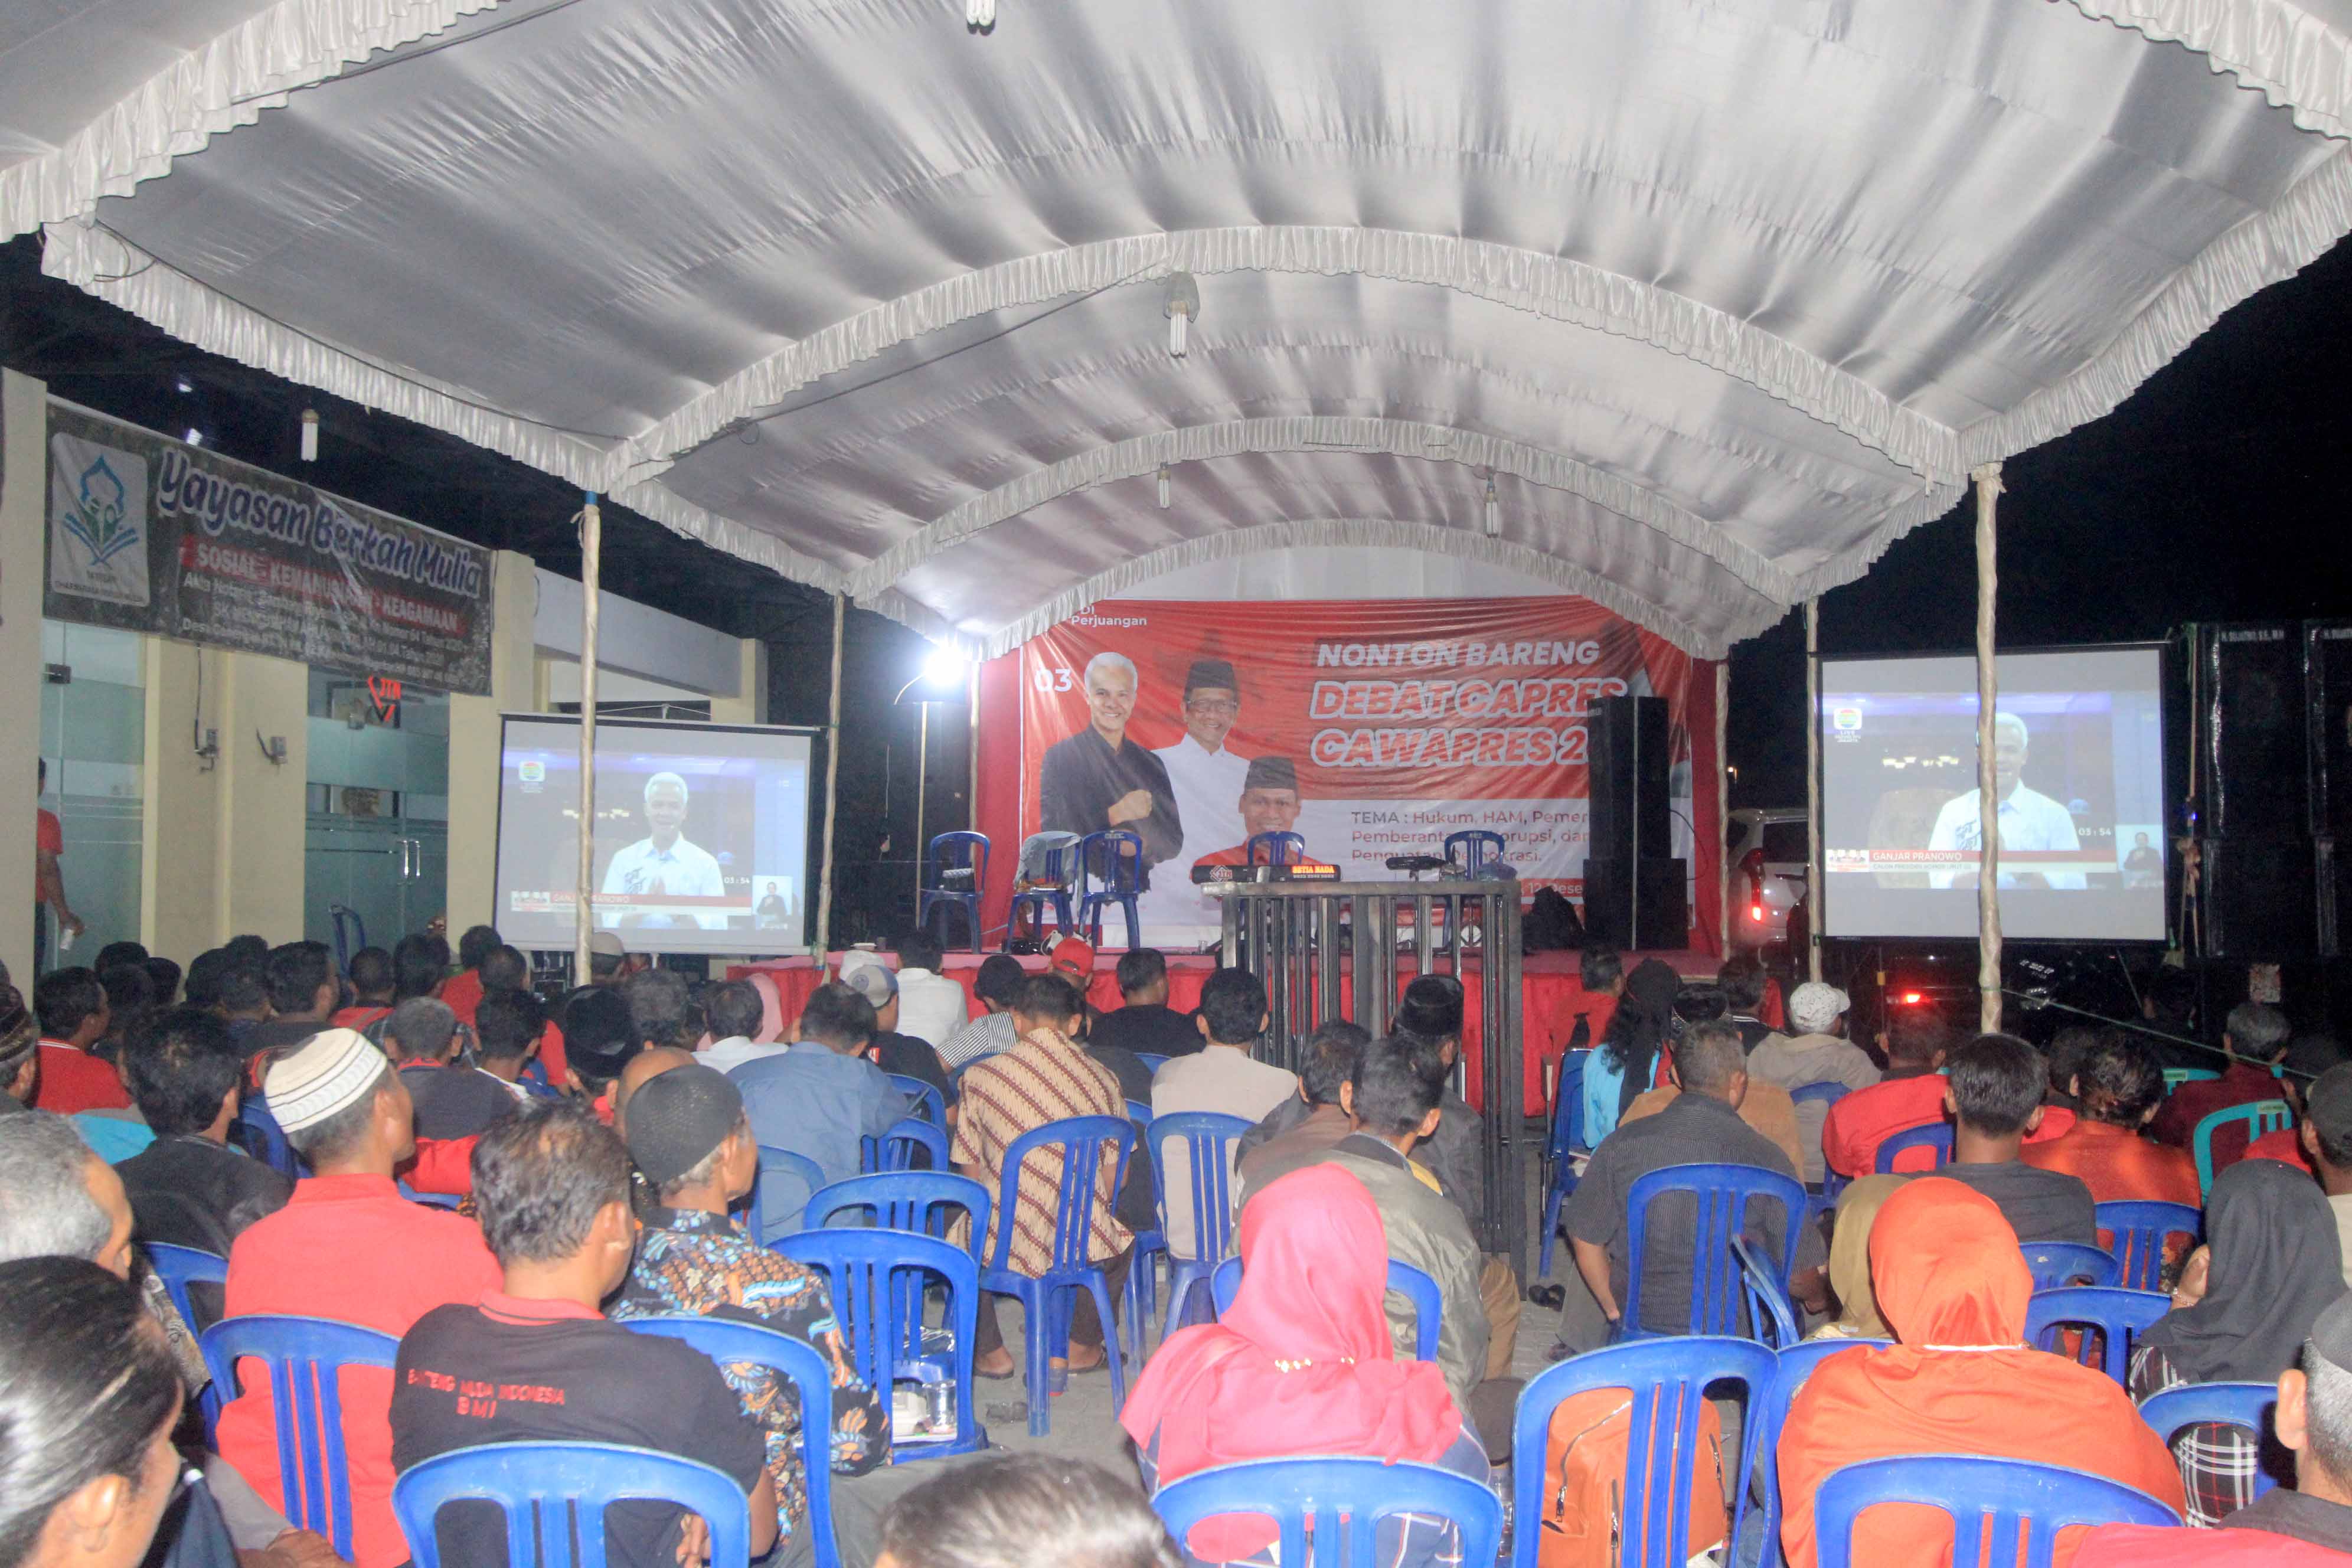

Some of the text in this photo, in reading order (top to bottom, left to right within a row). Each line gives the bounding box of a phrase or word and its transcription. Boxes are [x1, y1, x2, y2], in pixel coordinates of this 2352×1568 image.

[156, 447, 482, 599] Yayasan Berkah Mulia
[384, 594, 459, 631] KEAGAMAAN
[1072, 615, 1147, 628] Perjuangan
[1317, 641, 1600, 667] NONTON BARENG
[1034, 668, 1072, 692] 03
[1309, 680, 1458, 719] DEBAT
[1311, 727, 1559, 767] CAWAPRES
[1351, 811, 1399, 824] TEMA
[1413, 811, 1477, 825] Hukum,
[1483, 811, 1527, 825] HAM,
[1503, 829, 1556, 845] orupsi,
[1873, 851, 1962, 861] GANJAR PRANOWO
[456, 1396, 497, 1419] BMI
